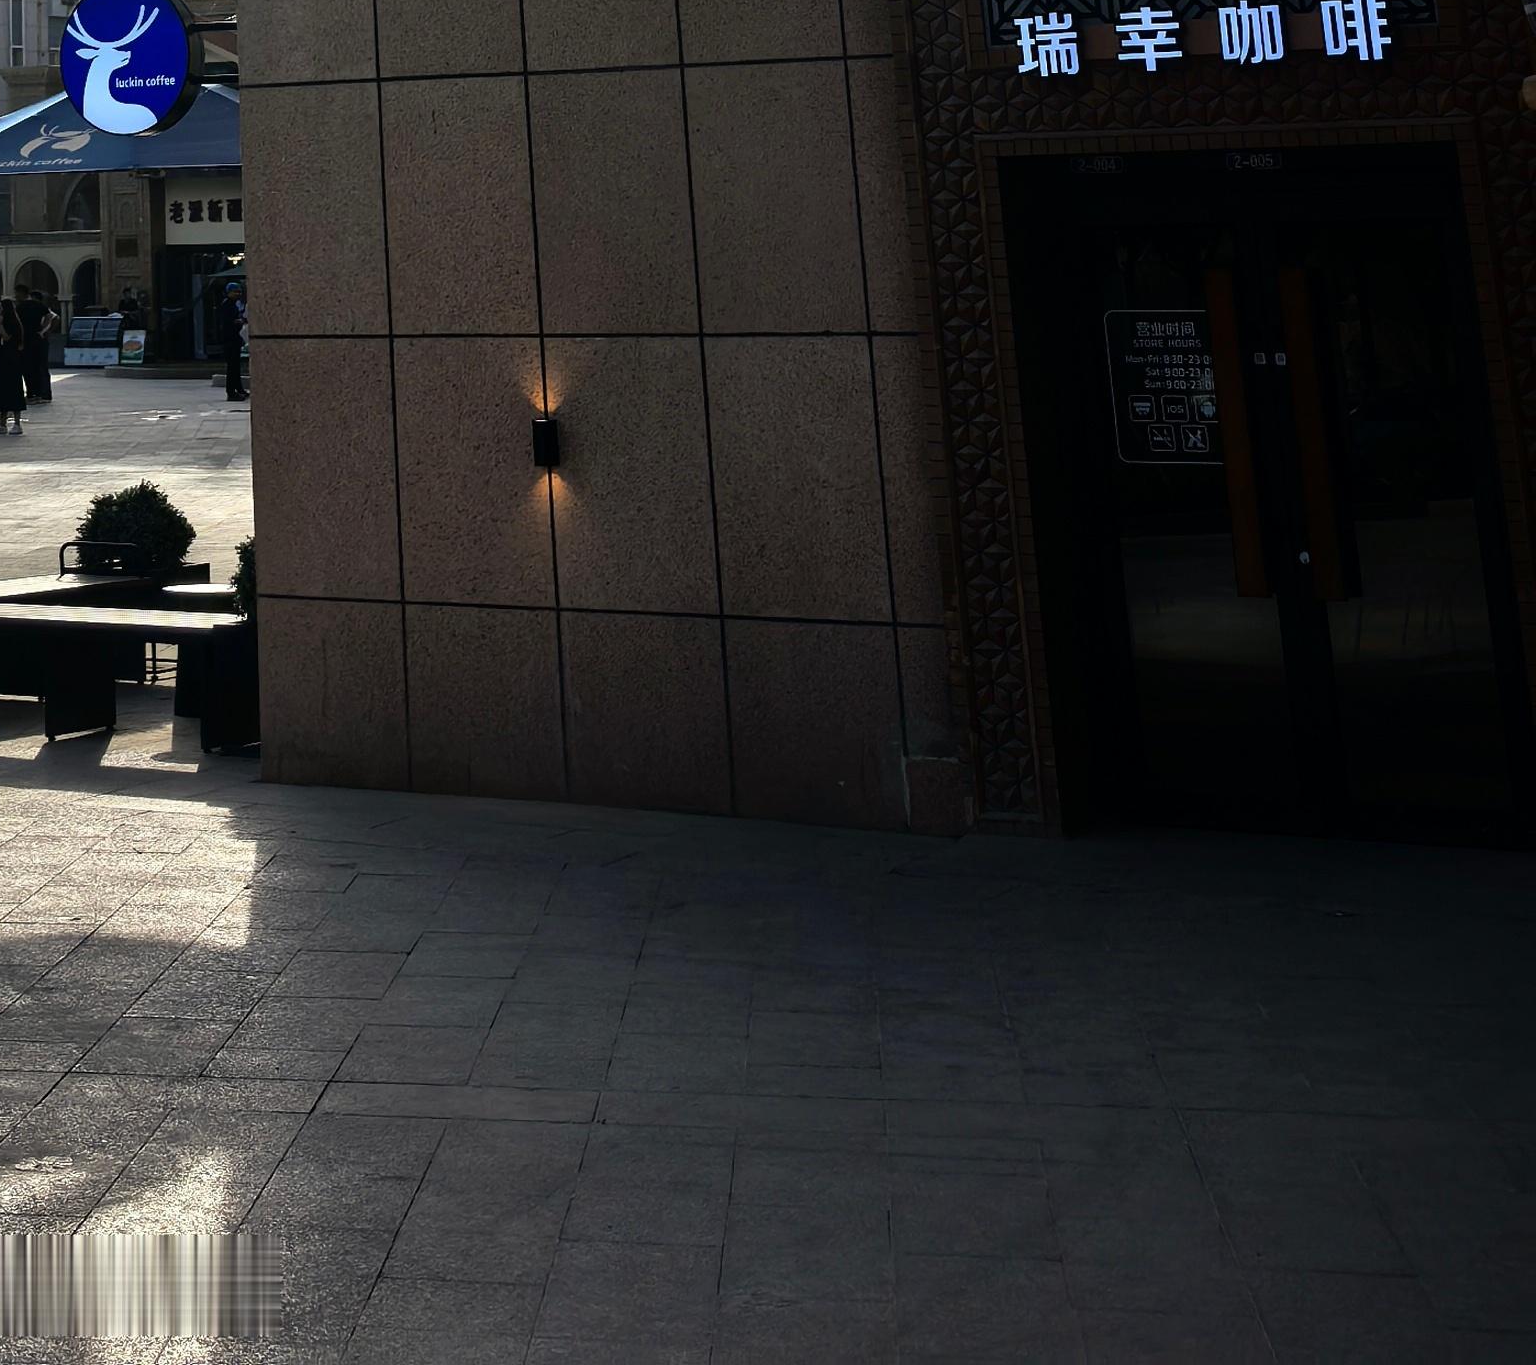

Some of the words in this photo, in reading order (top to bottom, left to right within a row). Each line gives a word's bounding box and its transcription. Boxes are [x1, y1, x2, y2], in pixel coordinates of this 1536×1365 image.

[115, 76, 144, 88] luckin
[145, 74, 176, 87] coffee
[33, 156, 83, 166] coffee
[1135, 321, 1196, 337] 营业时间
[1132, 339, 1165, 348] STORE
[1168, 339, 1203, 348] HOURS
